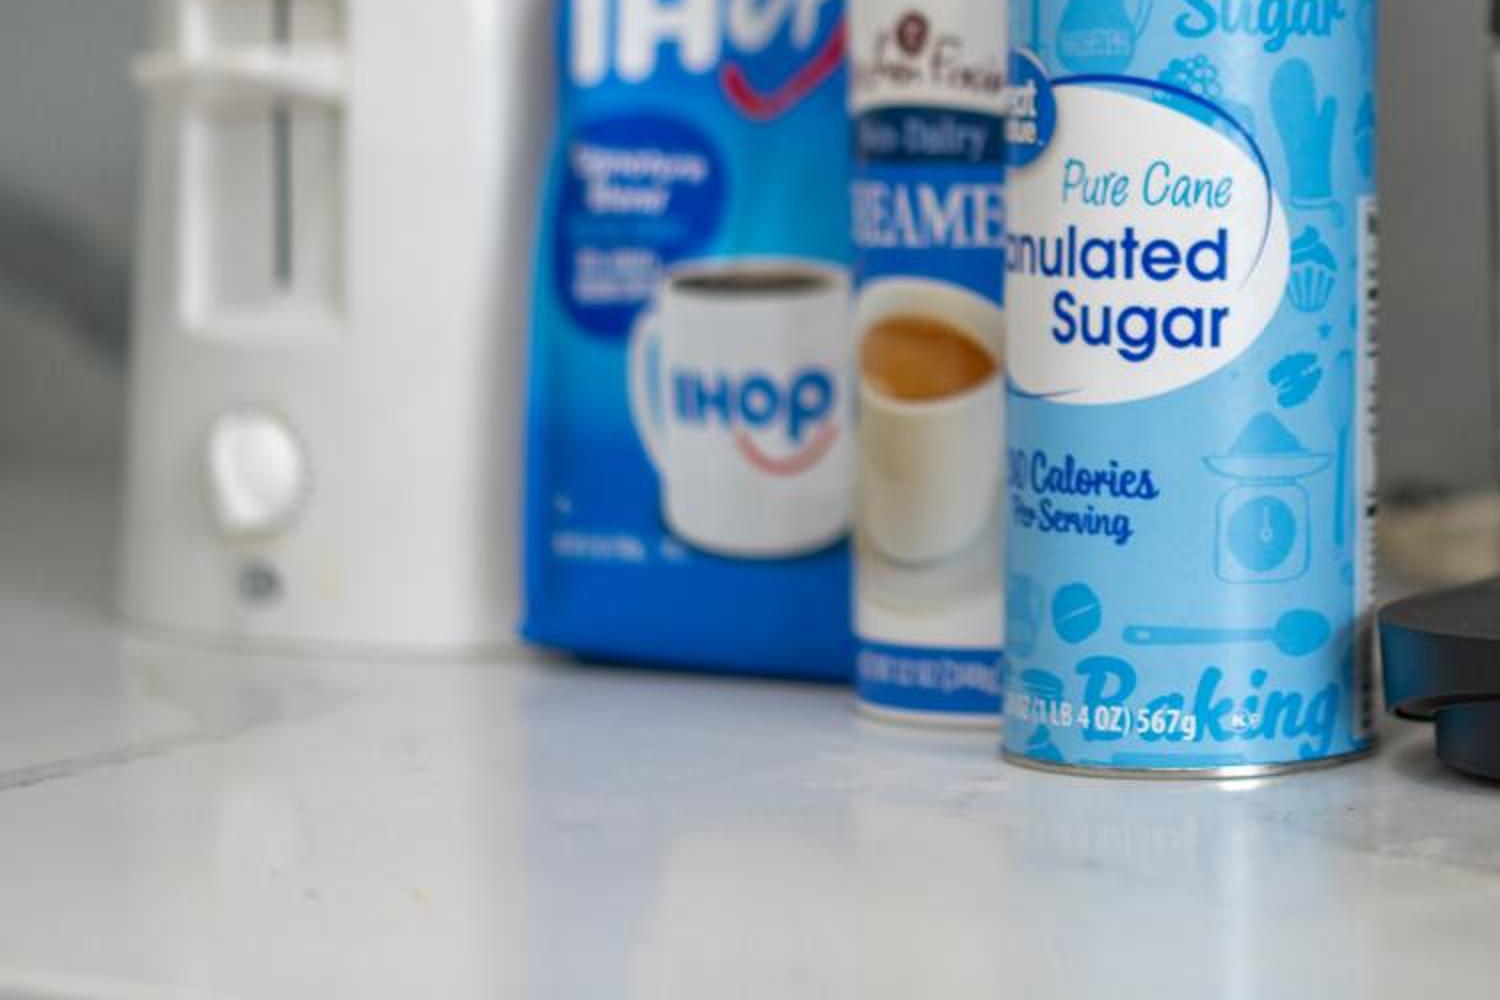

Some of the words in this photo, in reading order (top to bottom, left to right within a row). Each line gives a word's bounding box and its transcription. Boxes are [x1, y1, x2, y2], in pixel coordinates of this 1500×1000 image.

[1062, 158, 1130, 207] Pure
[1142, 160, 1233, 209] Cane
[1053, 289, 1230, 363] Sugar
[1031, 449, 1161, 500] Calories
[1038, 497, 1136, 547] Serving
[1074, 655, 1342, 762] Baking
[1076, 702, 1091, 730] 4
[1094, 704, 1131, 736] OZ)
[1136, 708, 1198, 741] 567g
